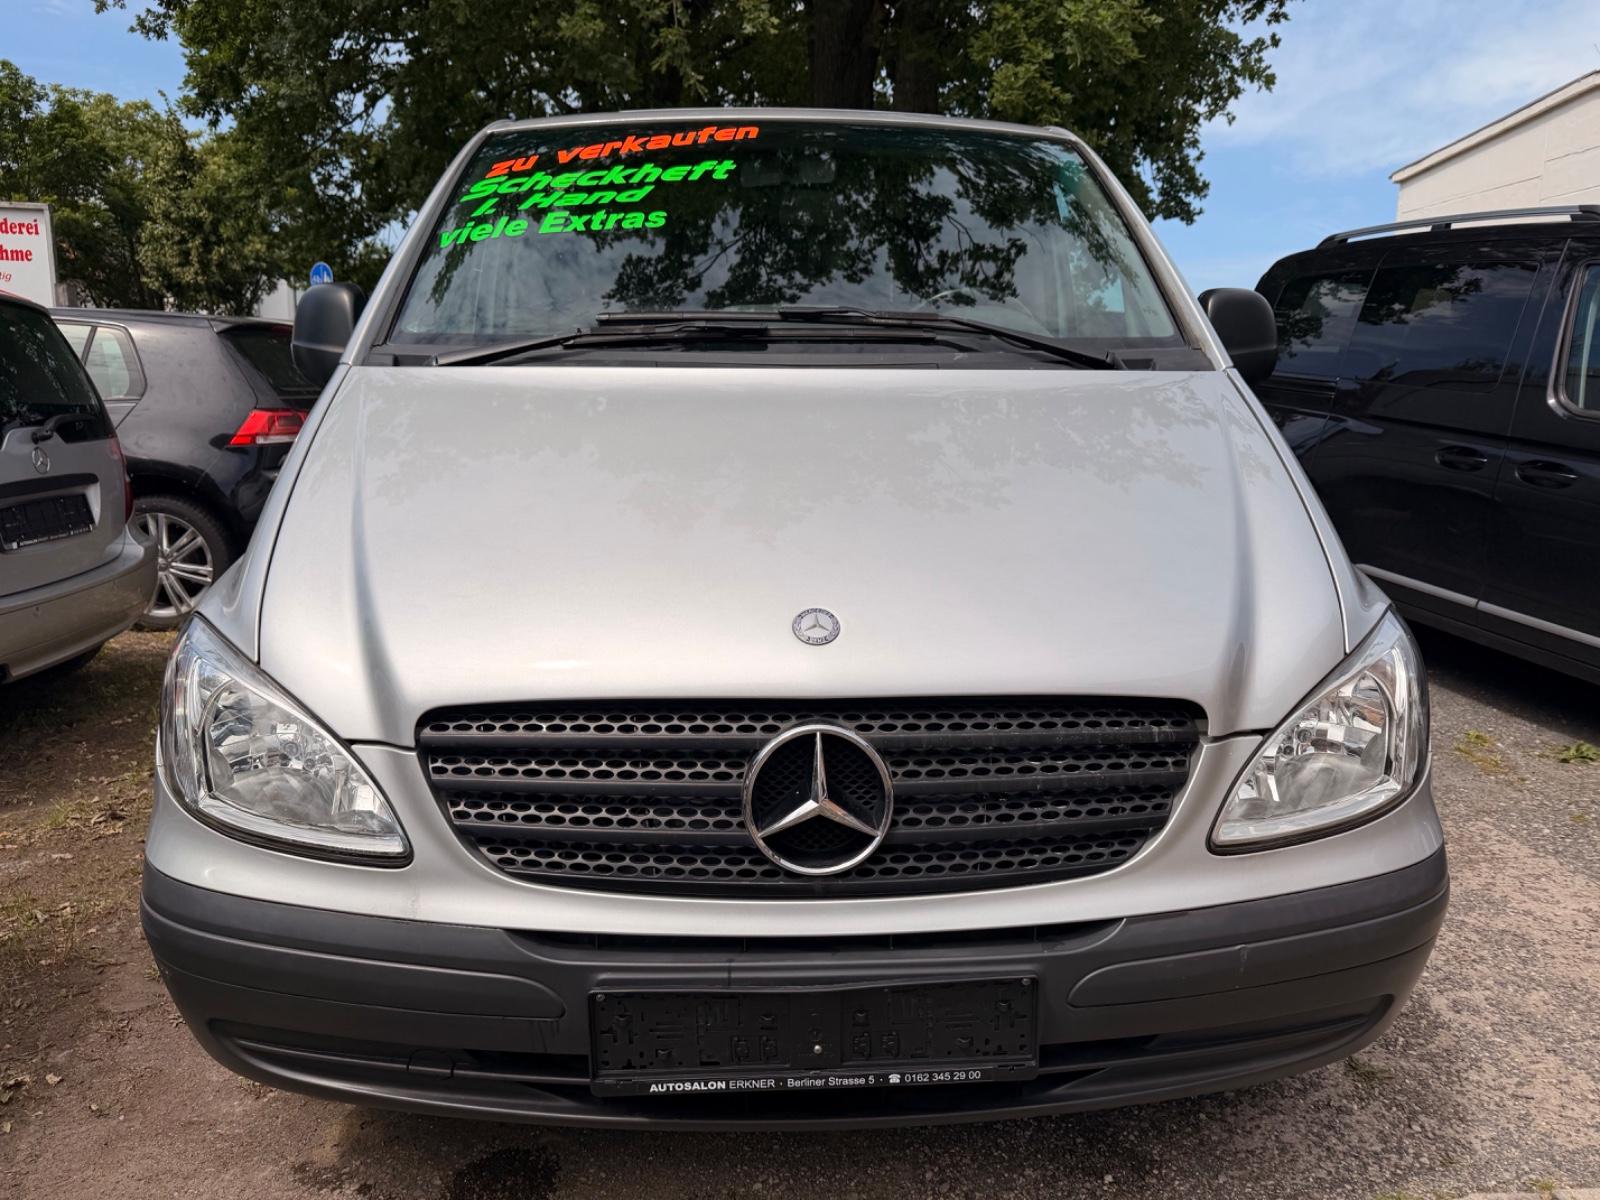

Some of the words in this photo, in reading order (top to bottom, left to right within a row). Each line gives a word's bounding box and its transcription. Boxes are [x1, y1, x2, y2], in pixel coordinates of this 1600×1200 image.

[486, 154, 539, 178] zu
[556, 126, 760, 164] verkaufen
[459, 159, 737, 203] Scheckheft
[470, 197, 499, 217] 1.
[517, 184, 655, 210] Hand
[438, 215, 529, 248] viele
[538, 209, 667, 234] Extras
[649, 1080, 726, 1093] AUTOSALON
[728, 1079, 776, 1089] ERKNER
[787, 1077, 826, 1088] Berliner
[828, 1076, 866, 1087] Strasse
[868, 1075, 875, 1085] 5
[904, 1073, 930, 1083] 0162
[932, 1072, 951, 1082] 345
[953, 1071, 966, 1081] 29
[968, 1070, 981, 1080] 00
